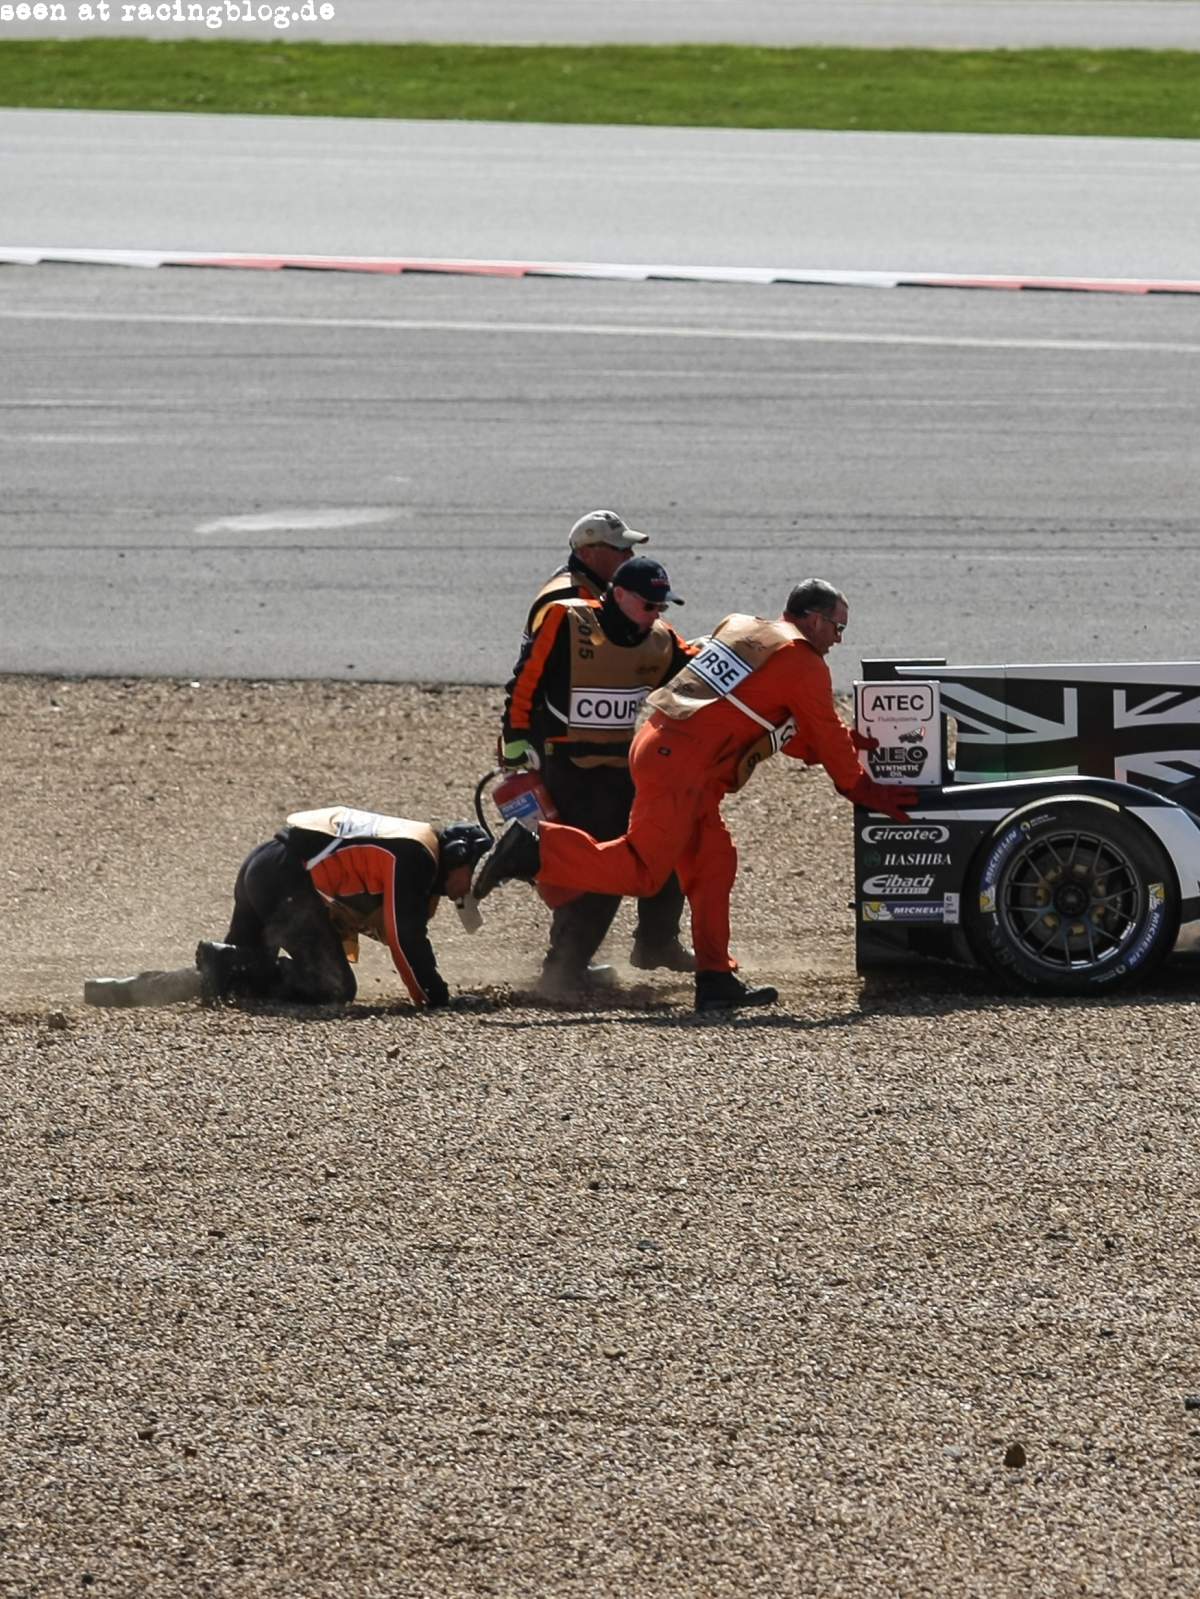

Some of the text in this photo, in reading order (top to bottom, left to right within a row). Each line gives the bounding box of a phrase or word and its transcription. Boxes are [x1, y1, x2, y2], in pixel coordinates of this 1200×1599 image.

[871, 694, 924, 711] ATEC
[868, 746, 928, 763] NEO
[876, 764, 920, 772] SYNTHETIC
[874, 828, 938, 840] zircotec
[884, 853, 952, 866] HASHIBA
[985, 830, 1017, 884] MICHELIN
[863, 874, 935, 894] Eibach
[1129, 912, 1160, 966] MICHELIN
